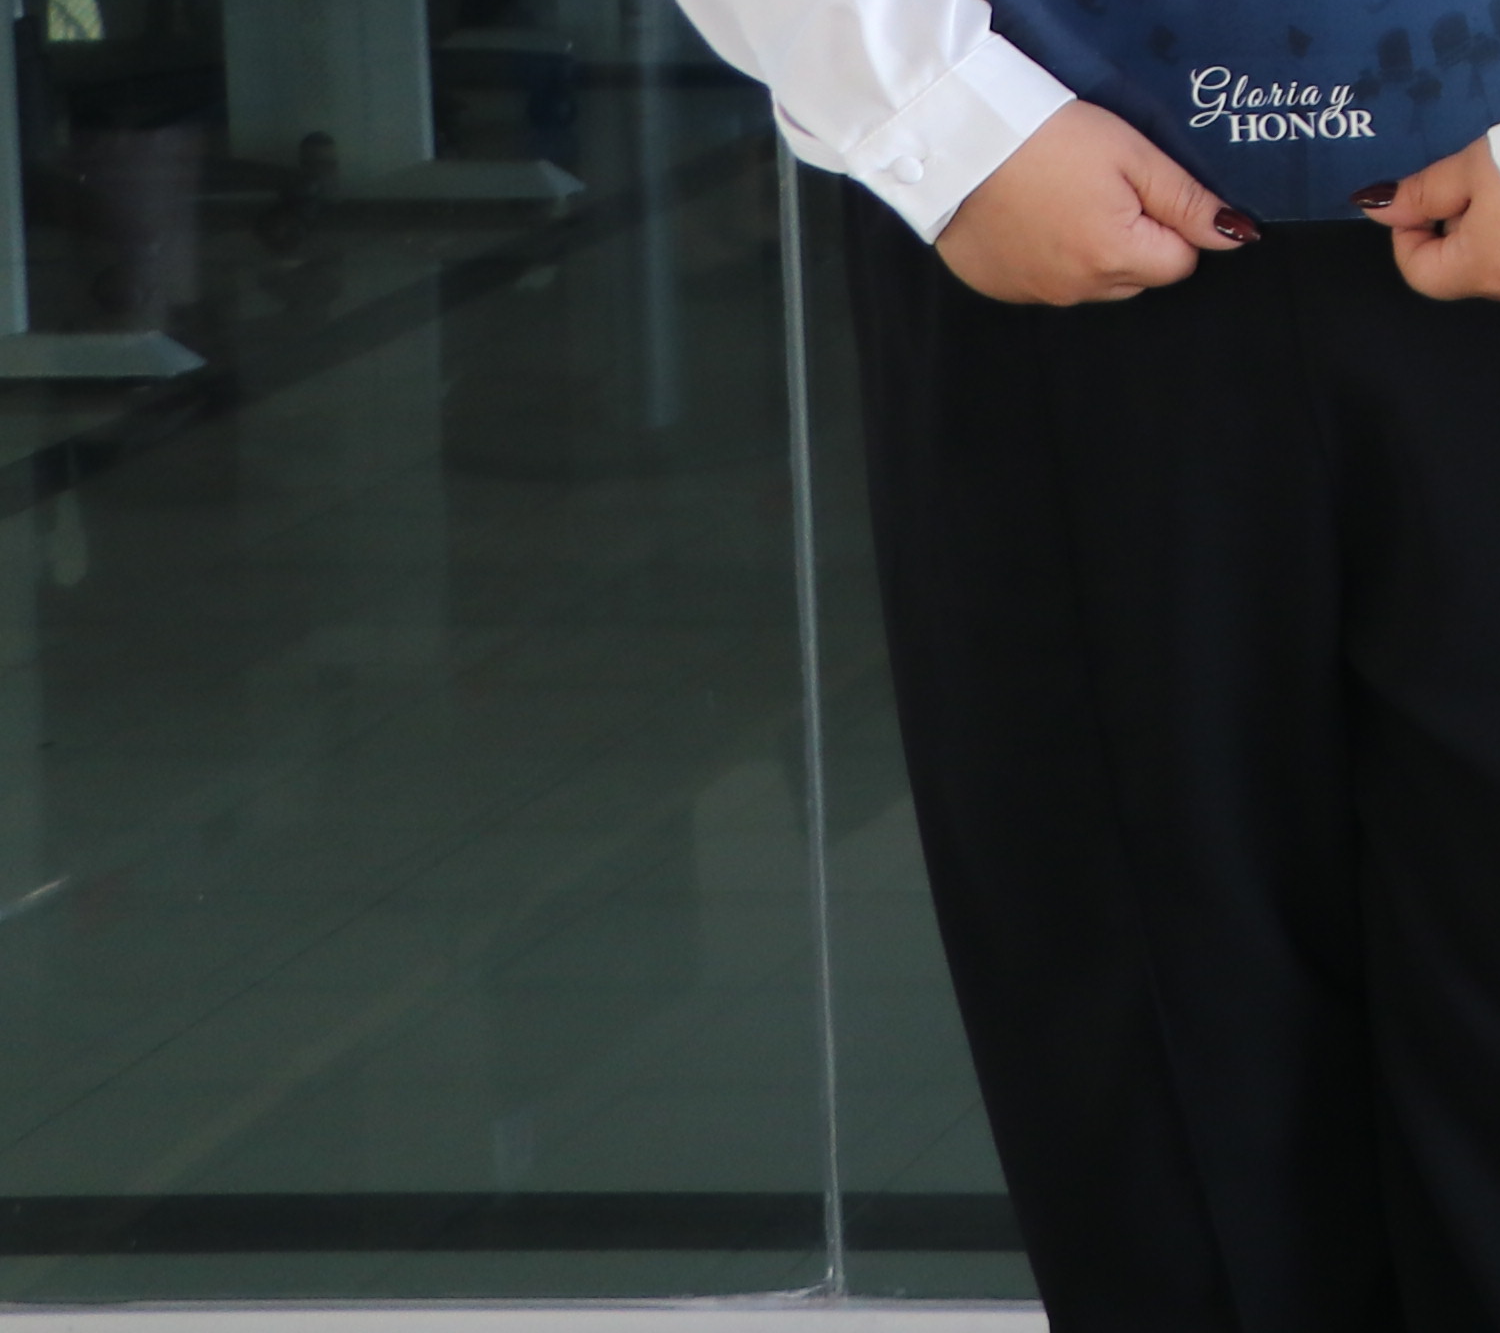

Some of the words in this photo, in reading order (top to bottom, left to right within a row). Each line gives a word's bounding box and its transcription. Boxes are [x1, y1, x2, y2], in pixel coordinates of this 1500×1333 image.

[1189, 65, 1322, 128] Gloria
[1321, 85, 1354, 120] y
[1229, 109, 1376, 143] HONOR
